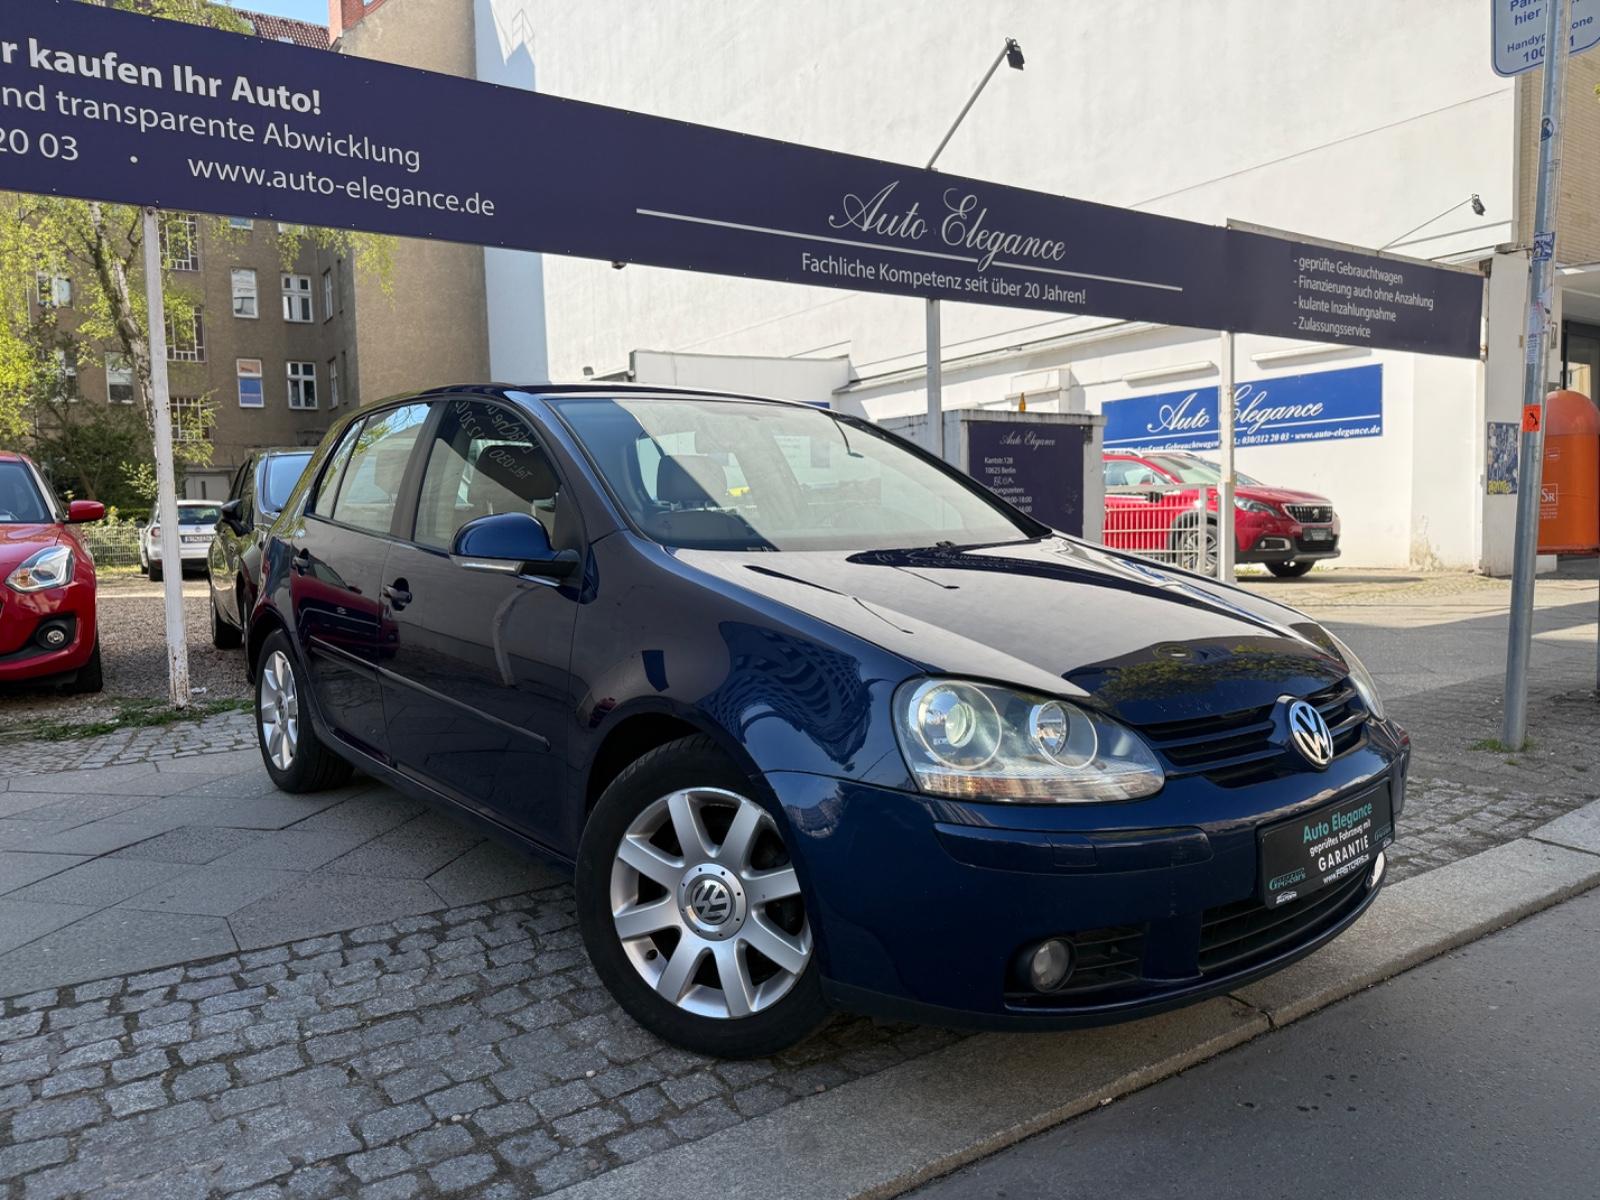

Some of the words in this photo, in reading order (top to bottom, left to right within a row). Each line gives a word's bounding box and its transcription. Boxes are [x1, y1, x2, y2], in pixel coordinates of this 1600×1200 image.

[1514, 9, 1541, 26] hier
[28, 37, 163, 89] kaufen
[173, 64, 222, 98] Ihr
[231, 75, 321, 115] Auto!
[55, 90, 256, 143] transparente
[263, 122, 420, 173] Abwicklung
[39, 132, 79, 161] 03
[188, 158, 495, 216] www.auto-elegance.de
[828, 180, 928, 241] Auto
[940, 187, 1067, 272] Elegance
[801, 252, 876, 281] Fachliche
[879, 263, 962, 293] Kompetenz
[965, 276, 989, 295] seit
[991, 277, 1022, 299] über
[1024, 281, 1040, 300] 20
[1042, 282, 1087, 305] Jahren!
[1299, 257, 1335, 272] geprüfte
[1336, 260, 1403, 285] Gebrauchtwagen
[1299, 275, 1352, 298] Finanzierung
[1353, 285, 1372, 299] auch
[1374, 288, 1393, 302] ohne
[1394, 291, 1434, 311] Anzahlung
[1299, 296, 1330, 313] kulante
[1331, 301, 1396, 321] Inzahlungnahme
[1299, 316, 1371, 338] Zulassungsservice
[1147, 393, 1210, 433] Auto
[1295, 425, 1380, 440] www.auto-elegance.de
[1303, 822, 1330, 844] Auto
[1331, 802, 1373, 830] Elegance
[1318, 834, 1370, 872] GARANTIE
